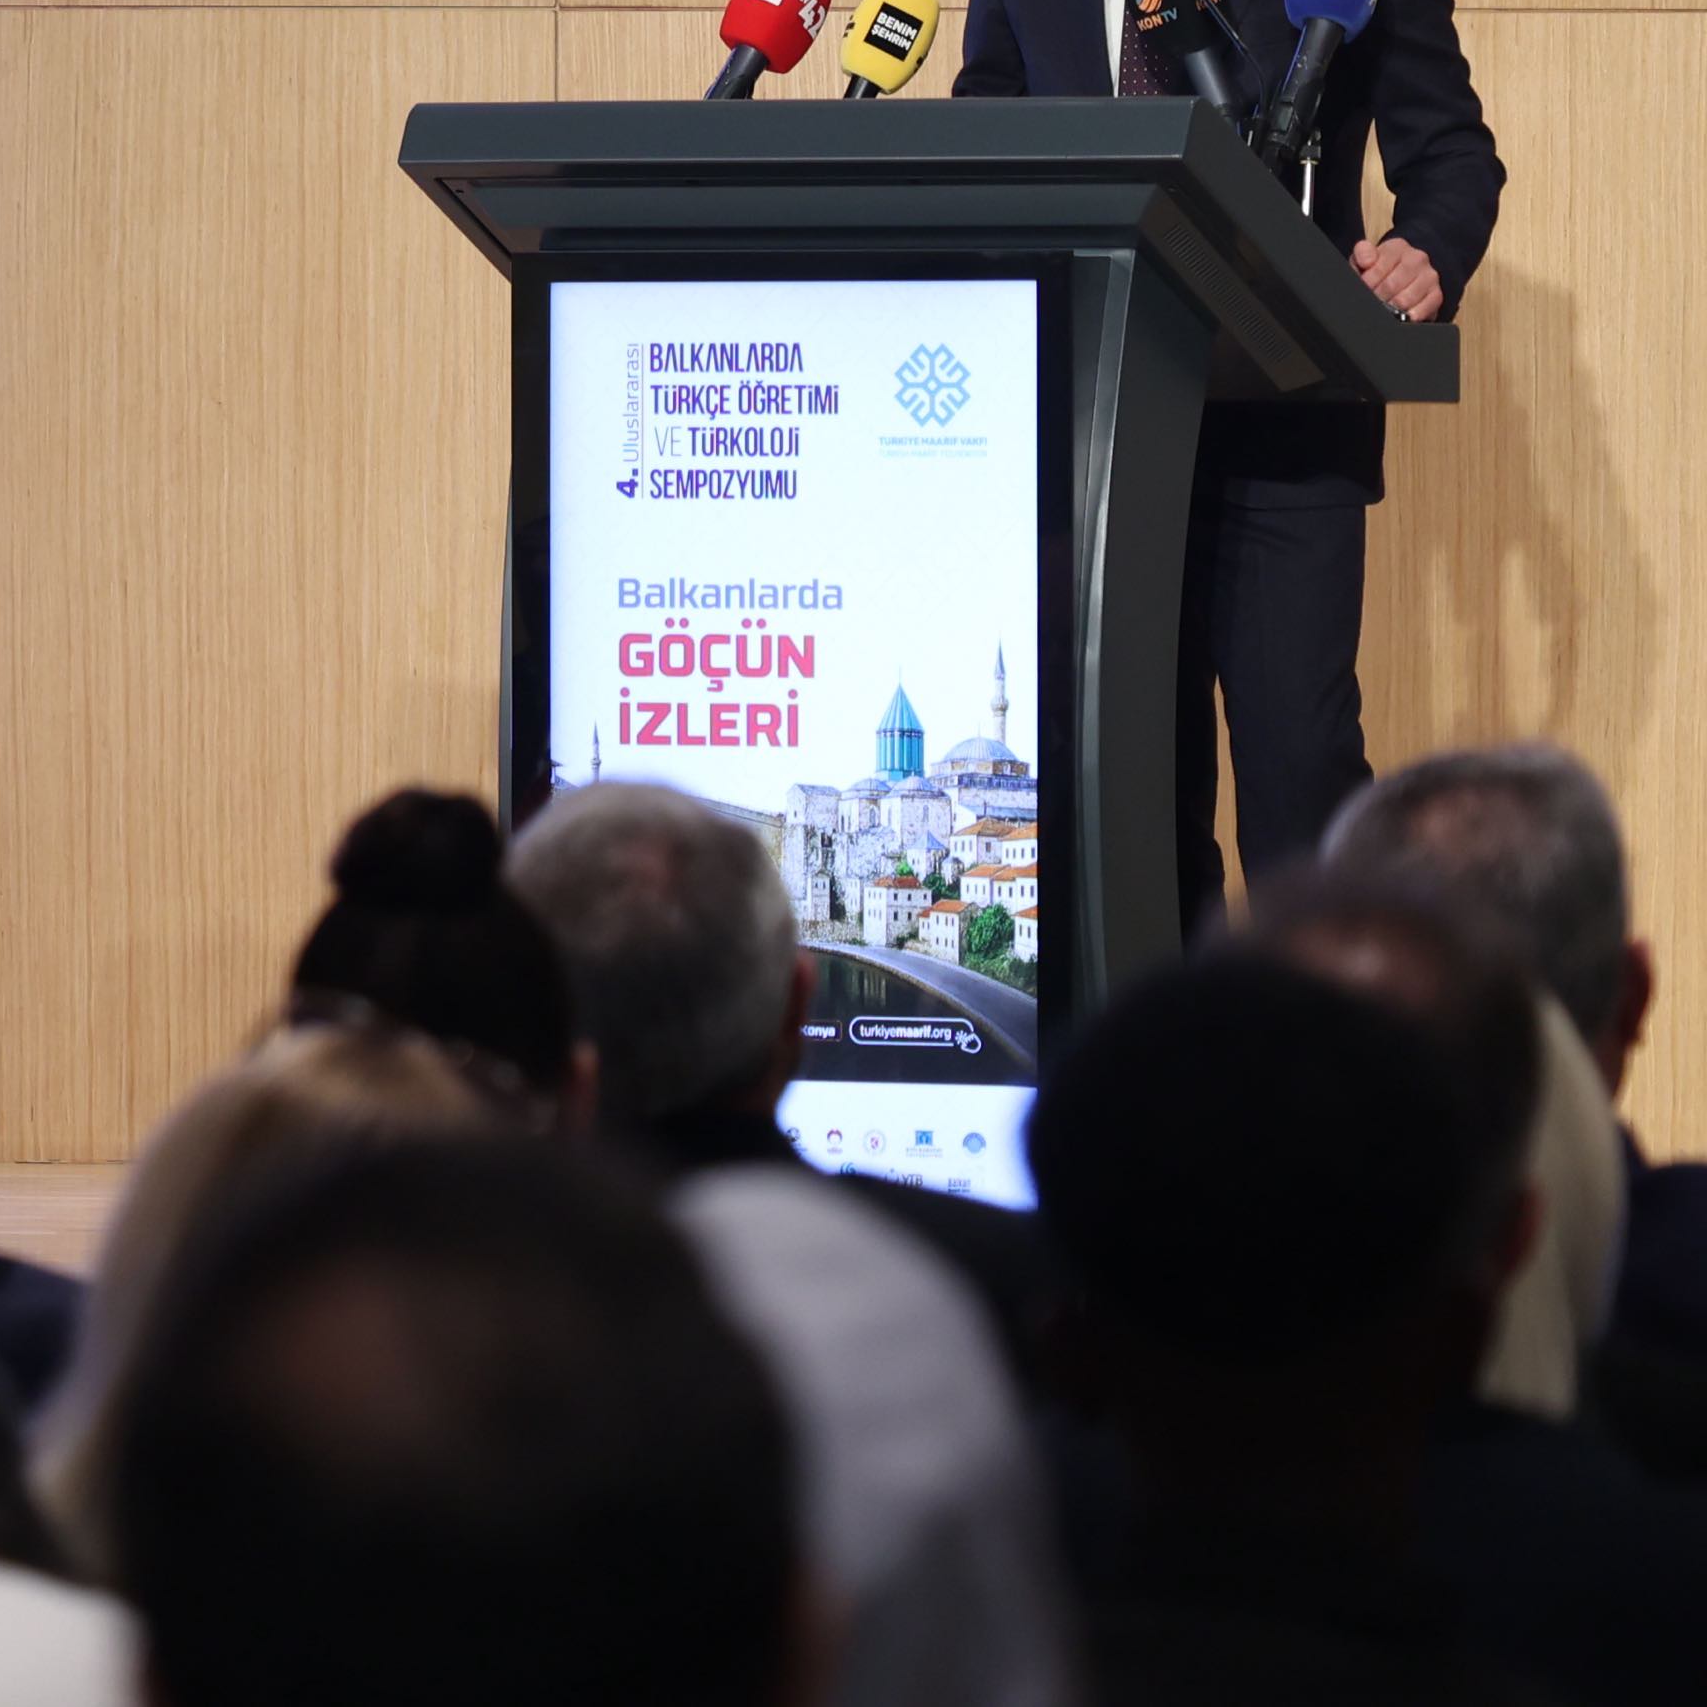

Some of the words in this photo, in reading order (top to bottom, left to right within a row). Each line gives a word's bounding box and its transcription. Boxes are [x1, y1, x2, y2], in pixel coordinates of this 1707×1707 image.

[871, 24, 912, 51] ŞEHRİM
[876, 11, 918, 41] BENİM
[649, 342, 804, 373] BALKANLARDA
[622, 343, 640, 463] Uluslararası
[650, 384, 731, 421] TÜRKÇE
[738, 380, 840, 416] ÖĞRETİMİ
[654, 425, 682, 457] VE
[688, 426, 800, 457] TÜRKOLOJİ
[616, 468, 639, 499] 4.
[649, 468, 798, 500] SEMPOZYUMU
[618, 577, 844, 611] Balkanlarda
[618, 616, 815, 693] GÖÇÜN
[619, 686, 799, 748] İZLERİ
[860, 1024, 953, 1041] turkiyemaarif.org
